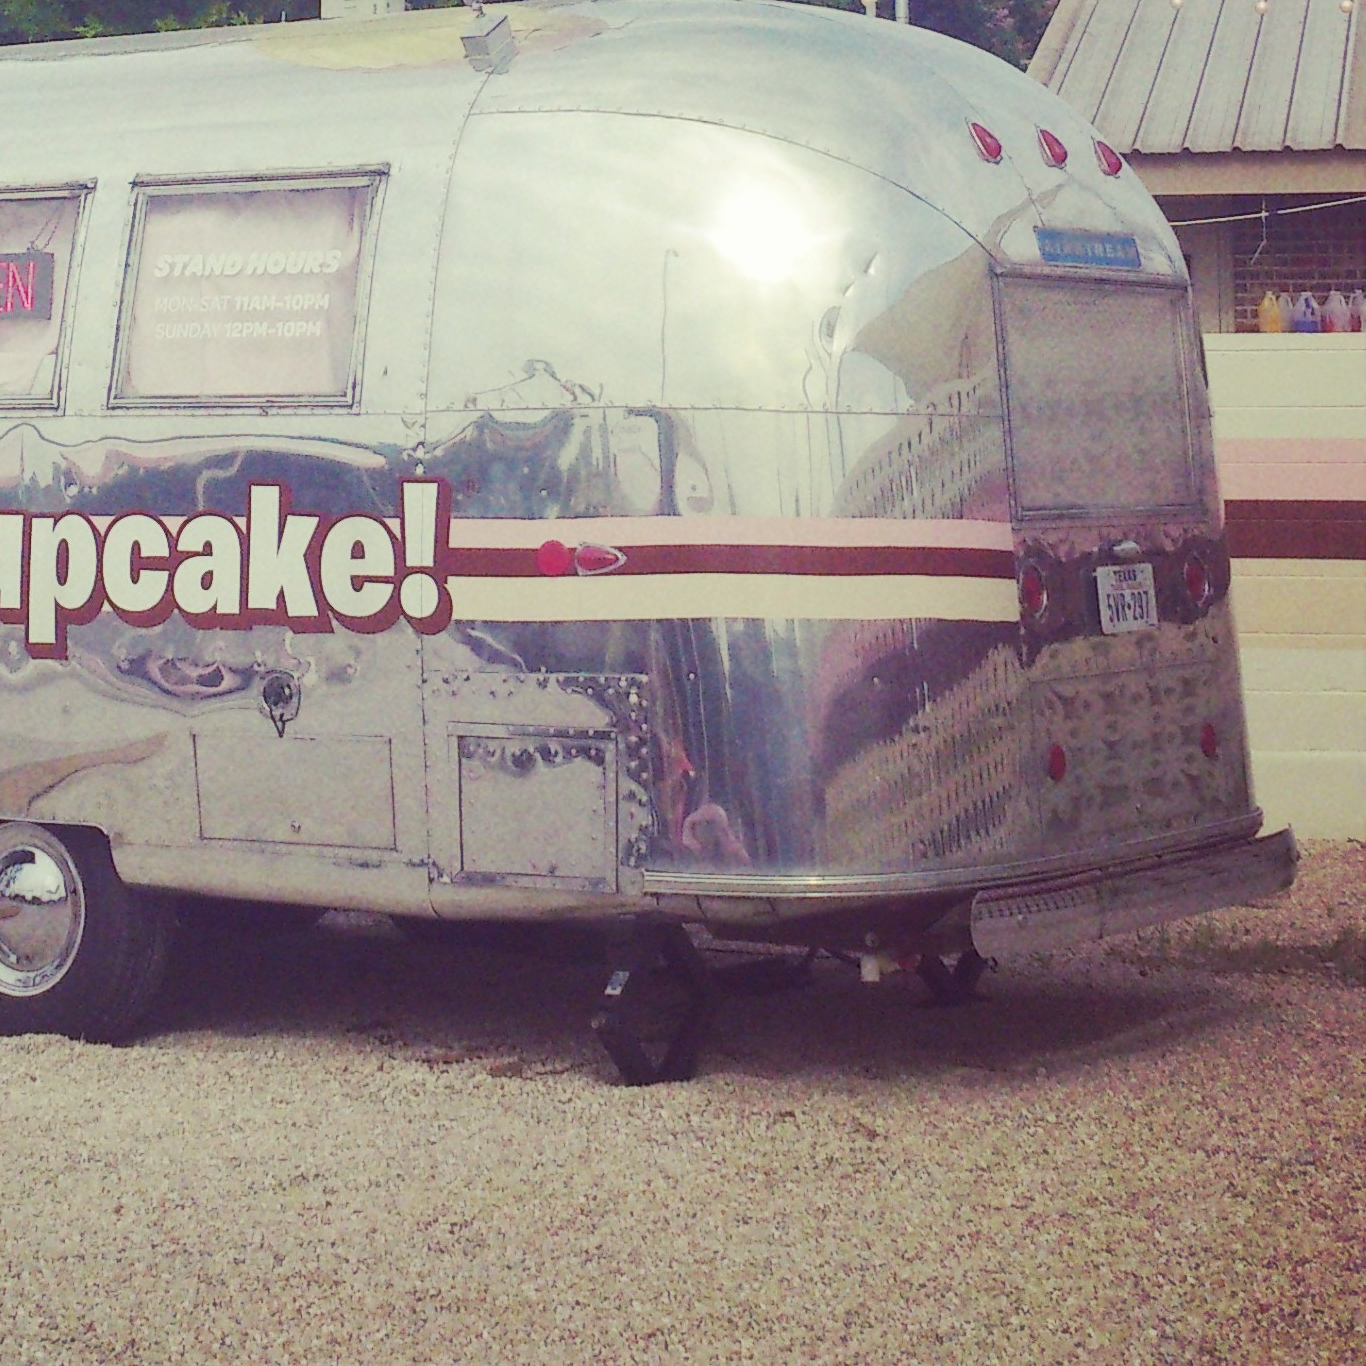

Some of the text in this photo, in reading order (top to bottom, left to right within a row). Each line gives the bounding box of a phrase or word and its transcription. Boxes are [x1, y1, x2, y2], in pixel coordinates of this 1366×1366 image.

[153, 249, 342, 277] STAND HOURS
[154, 293, 331, 312] MON-SAT 11AM-10PM
[156, 320, 322, 339] SUNDAY 12PM-10PM
[1113, 569, 1137, 583] TEXAS
